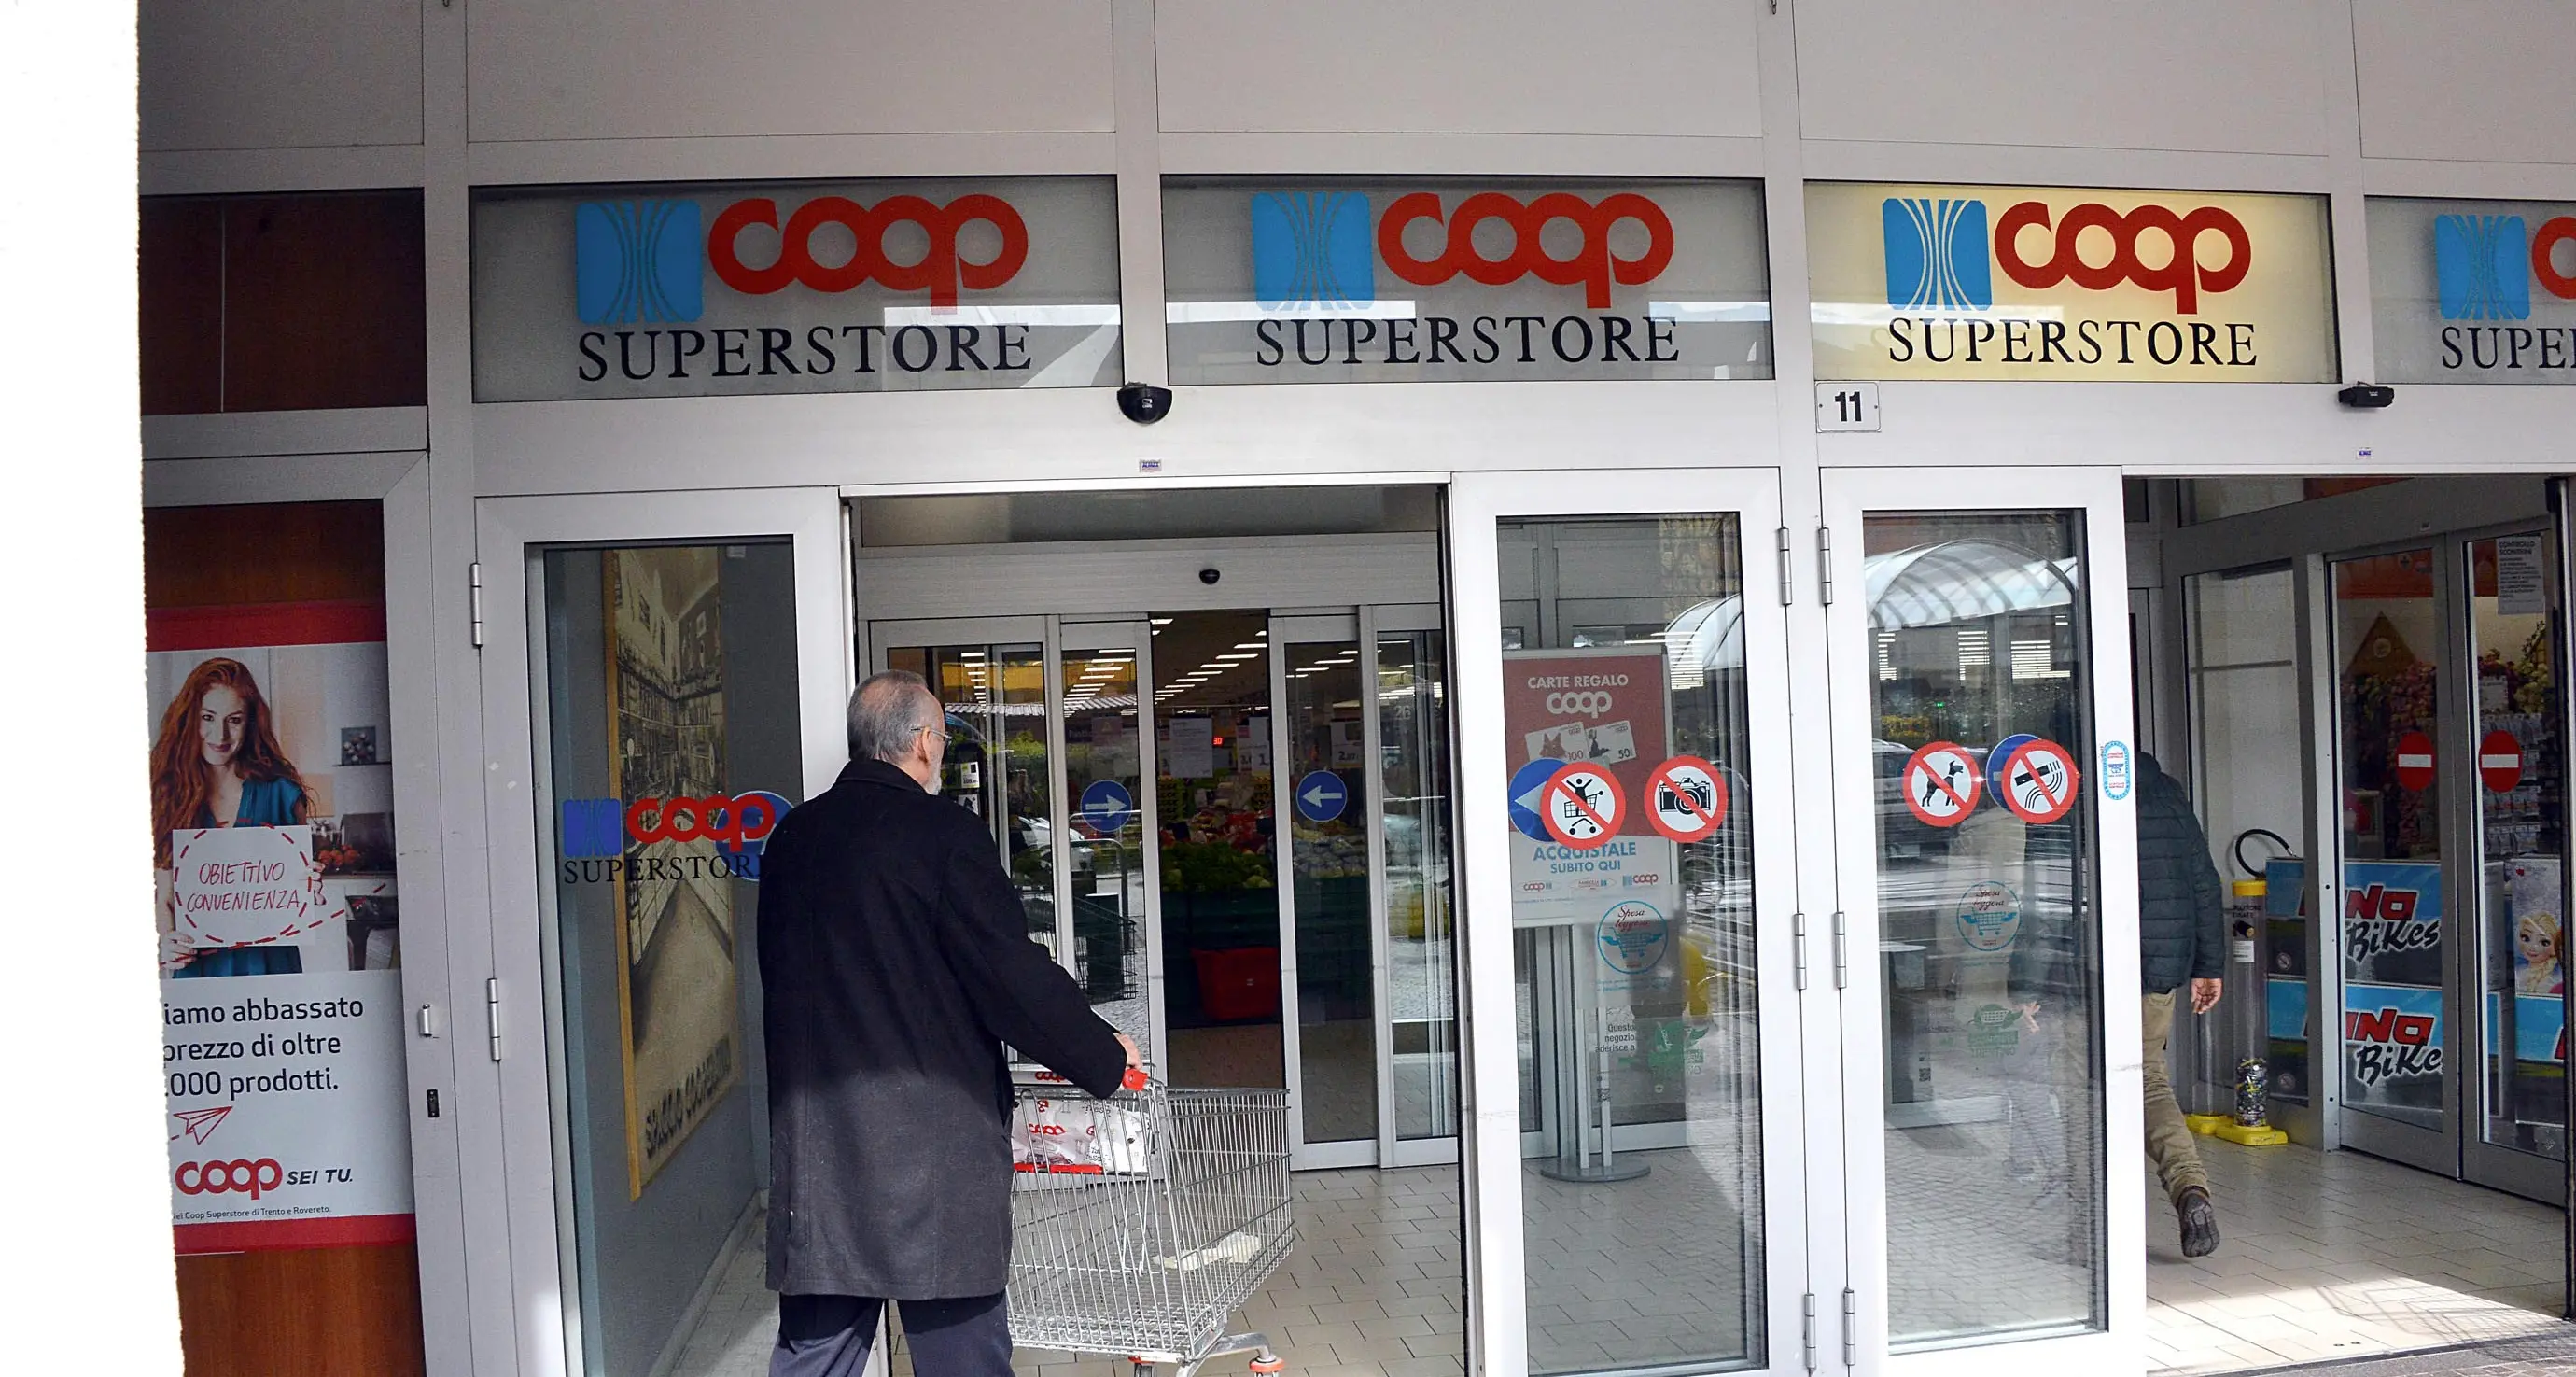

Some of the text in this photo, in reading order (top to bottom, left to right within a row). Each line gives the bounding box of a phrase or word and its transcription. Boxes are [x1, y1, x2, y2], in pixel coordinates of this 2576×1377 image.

[707, 193, 1029, 316] coop
[1377, 192, 1674, 309] coop
[1994, 201, 2252, 315] coop
[578, 323, 1032, 383] SUPERSTORE
[1256, 316, 1680, 367] SUPERSTORE
[1888, 316, 2258, 367] SUPERSTORE
[2441, 327, 2576, 370] SUPE
[1833, 390, 1863, 423] 11
[1528, 674, 1629, 690] CARTE REGALO
[1546, 691, 1613, 719] coop
[1617, 748, 1631, 760] 50
[626, 794, 776, 852] coop
[1533, 842, 1637, 862] ACQUISTALE
[1550, 860, 1621, 874] SUBITO QUI
[199, 860, 285, 885] OBIETTIVO
[564, 854, 762, 884] SUPERSTOR
[1633, 874, 1659, 886] coop
[187, 890, 300, 912] CONVENIENZA
[1617, 905, 1645, 920] Spesa
[2345, 885, 2418, 920] NO
[164, 997, 364, 1025] iamo abbassato
[163, 1032, 341, 1068] prezzo di oltre
[1604, 1035, 1635, 1044] negozio
[164, 1067, 339, 1102] .000 prodotti.
[175, 1158, 283, 1201] coop
[287, 1168, 354, 1186] SEI TU.
[185, 1212, 205, 1220] Coop
[207, 1210, 250, 1219] Superstore
[261, 1207, 286, 1215] Trento
